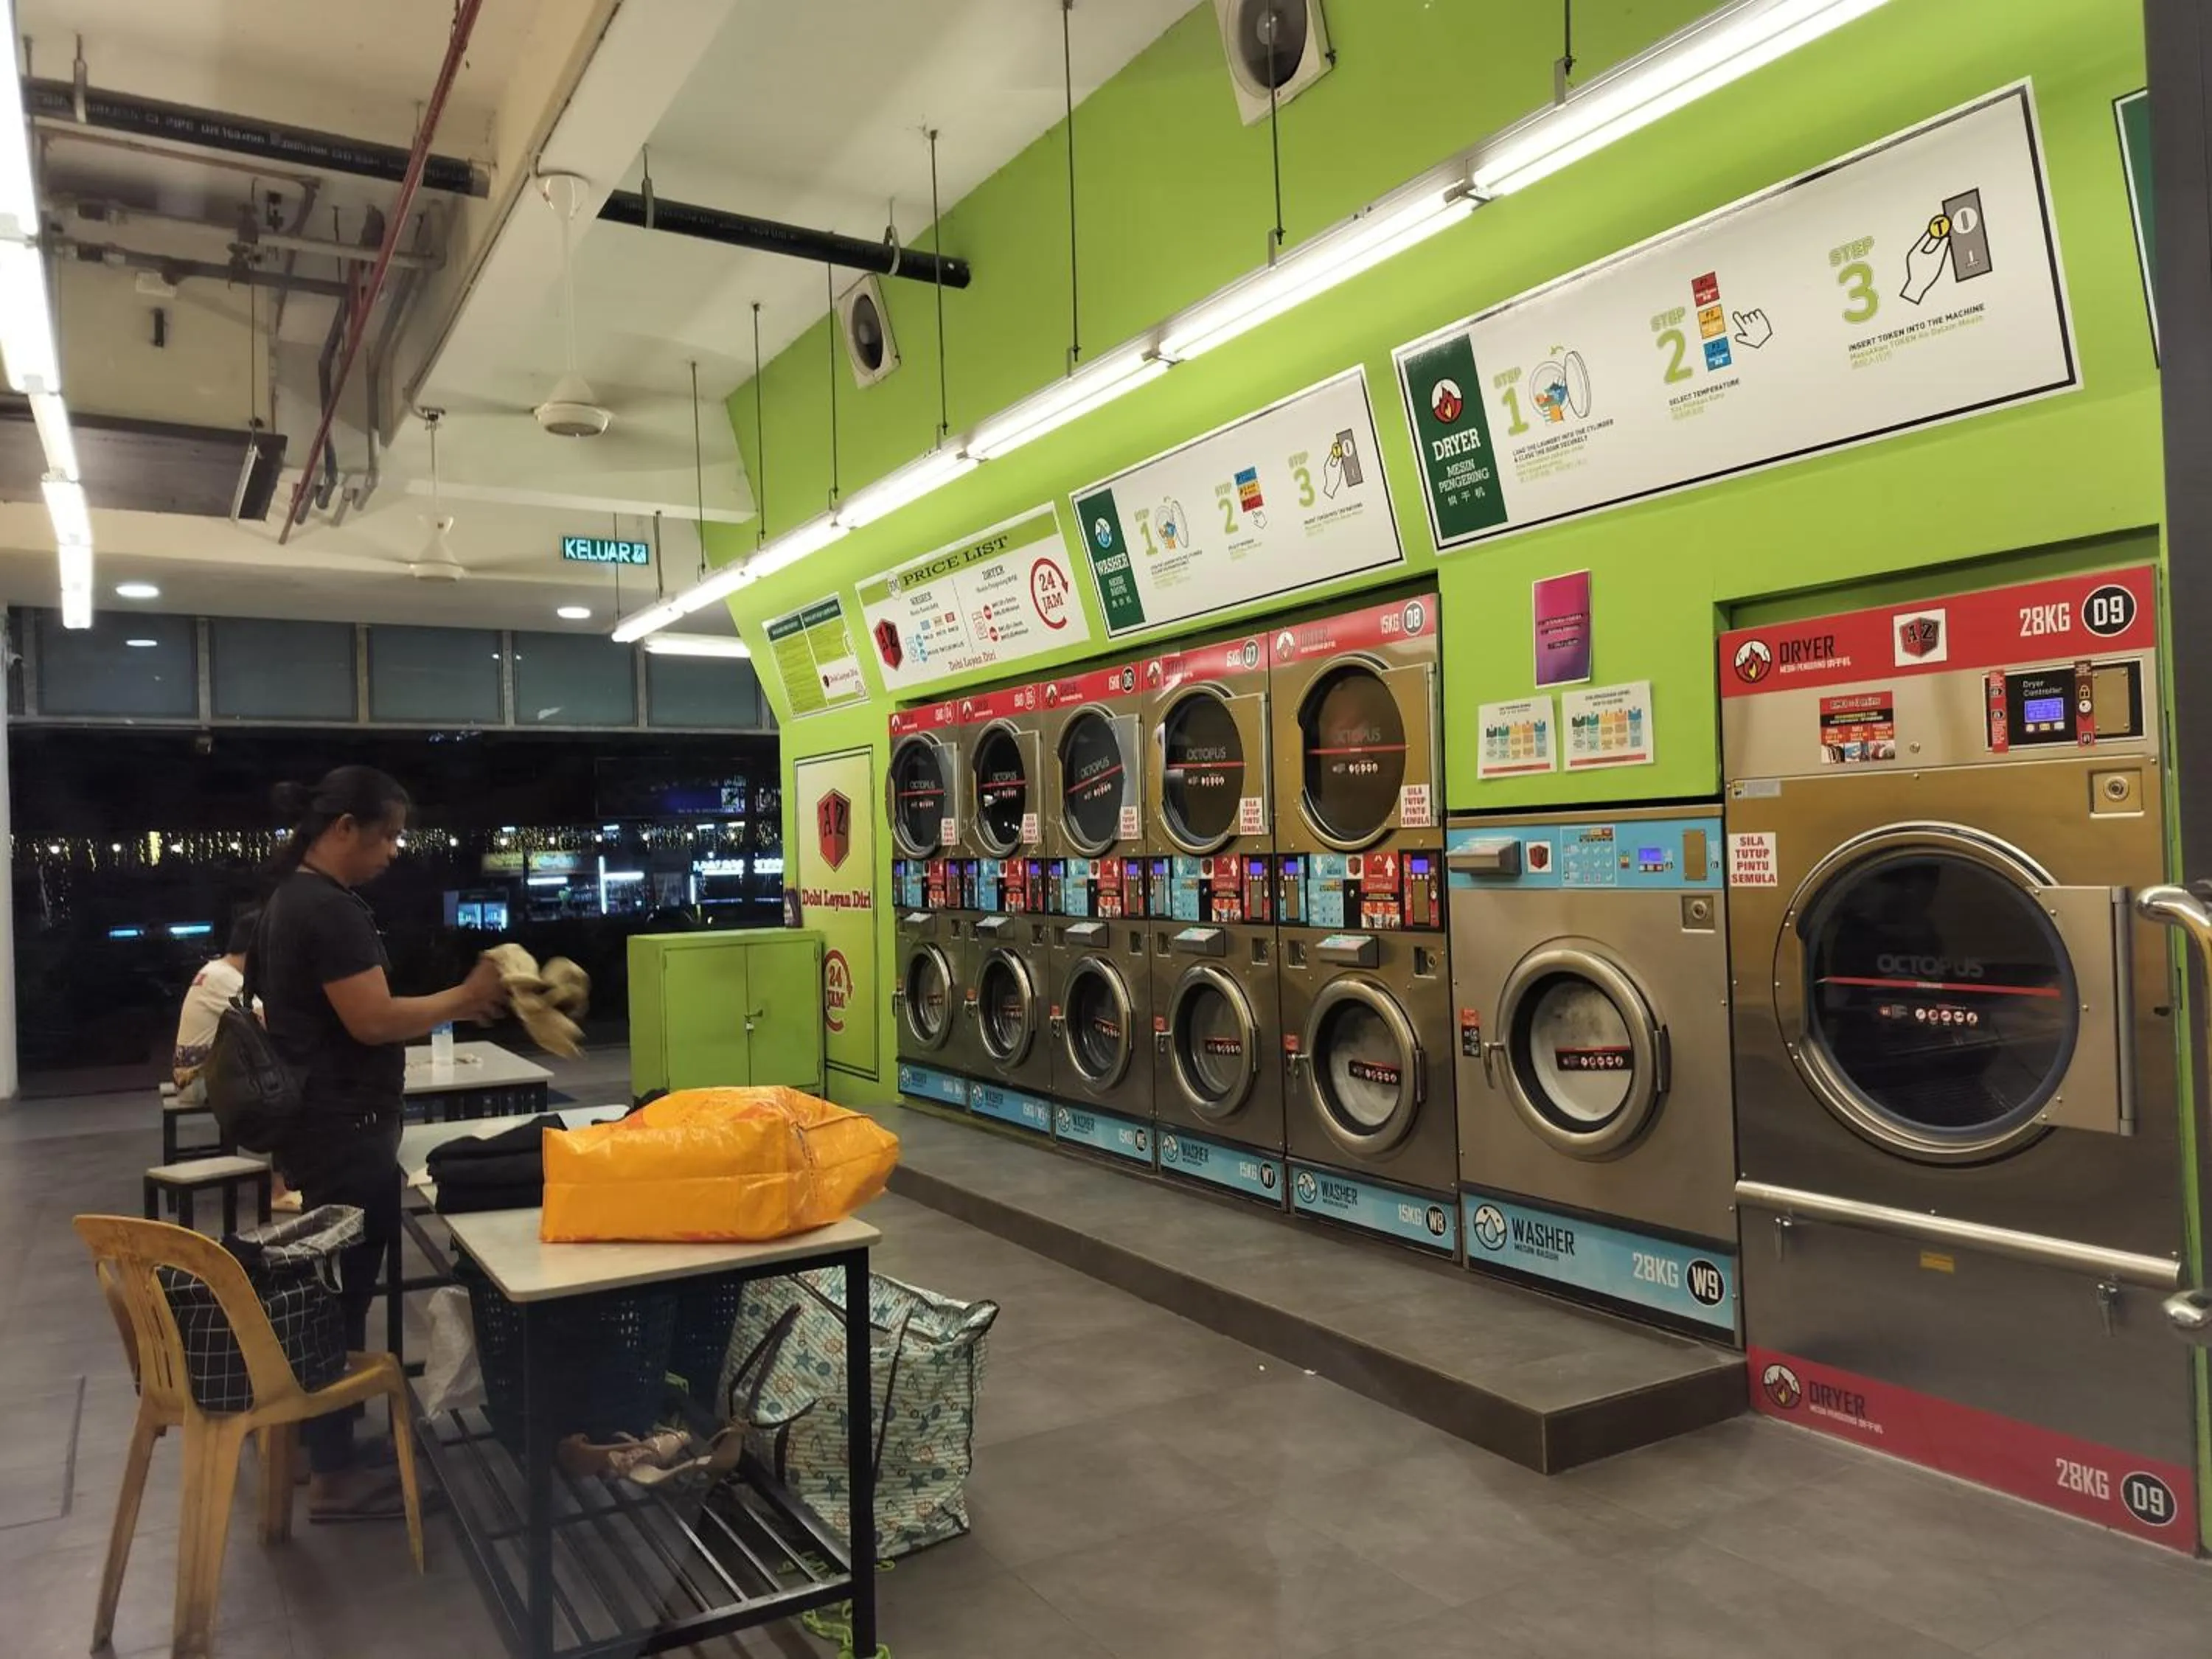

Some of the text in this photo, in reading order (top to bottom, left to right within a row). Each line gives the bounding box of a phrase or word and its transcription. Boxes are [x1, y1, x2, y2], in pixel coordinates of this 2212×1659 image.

[1829, 236, 1874, 267] STEP
[1839, 261, 1879, 324] 3
[1650, 306, 1686, 332] STEP
[1848, 302, 1985, 352] INSERT TOKEN INTO THE MACHINE
[1655, 329, 1694, 385] 2
[1493, 366, 1523, 389] STEP
[1669, 378, 1740, 406] SELECT TEMPERATURE
[1501, 387, 1530, 437] 1
[1431, 428, 1481, 462] DRYER
[1438, 467, 1489, 493] PENGERING
[1447, 458, 1475, 478] MESIN
[1293, 467, 1316, 507] 3
[1218, 498, 1239, 534] 2
[565, 538, 630, 563] KELUAR
[1141, 521, 1158, 555] 1
[903, 555, 960, 586] PRICE
[964, 535, 1008, 562] LIST
[1095, 552, 1130, 577] WASHER
[1039, 570, 1056, 591] 24
[1042, 592, 1063, 613] JAM
[2020, 595, 2125, 637] 28KG D9
[1780, 635, 1834, 664] DRYER
[2023, 680, 2045, 689] Dryer
[2023, 686, 2063, 697] Controller
[1186, 746, 1226, 762] OCTOPUS
[1080, 756, 1110, 779] OCTOPUS
[1405, 796, 1426, 805] TUTUP
[1405, 807, 1425, 815] PINTU
[1740, 836, 1764, 846] SILA
[1735, 849, 1770, 859] TUTUP
[1737, 860, 1769, 871] PINTU
[1731, 873, 1776, 883] SEMULA
[802, 888, 872, 912] Dobi Layan Diri
[829, 965, 842, 987] 24
[1877, 954, 1985, 979] OCTOPUS
[827, 989, 846, 1010] JAM
[1072, 1113, 1096, 1133] WASHER
[1182, 1141, 1210, 1163] WASHER
[1321, 1180, 1358, 1206] WASHER
[1398, 1203, 1422, 1225] 15KG
[1511, 1217, 1575, 1256] WASHER
[1633, 1250, 1720, 1301] 28KG W9
[1809, 1380, 1866, 1421] DRYER
[2056, 1457, 2166, 1517] 28KG D9
